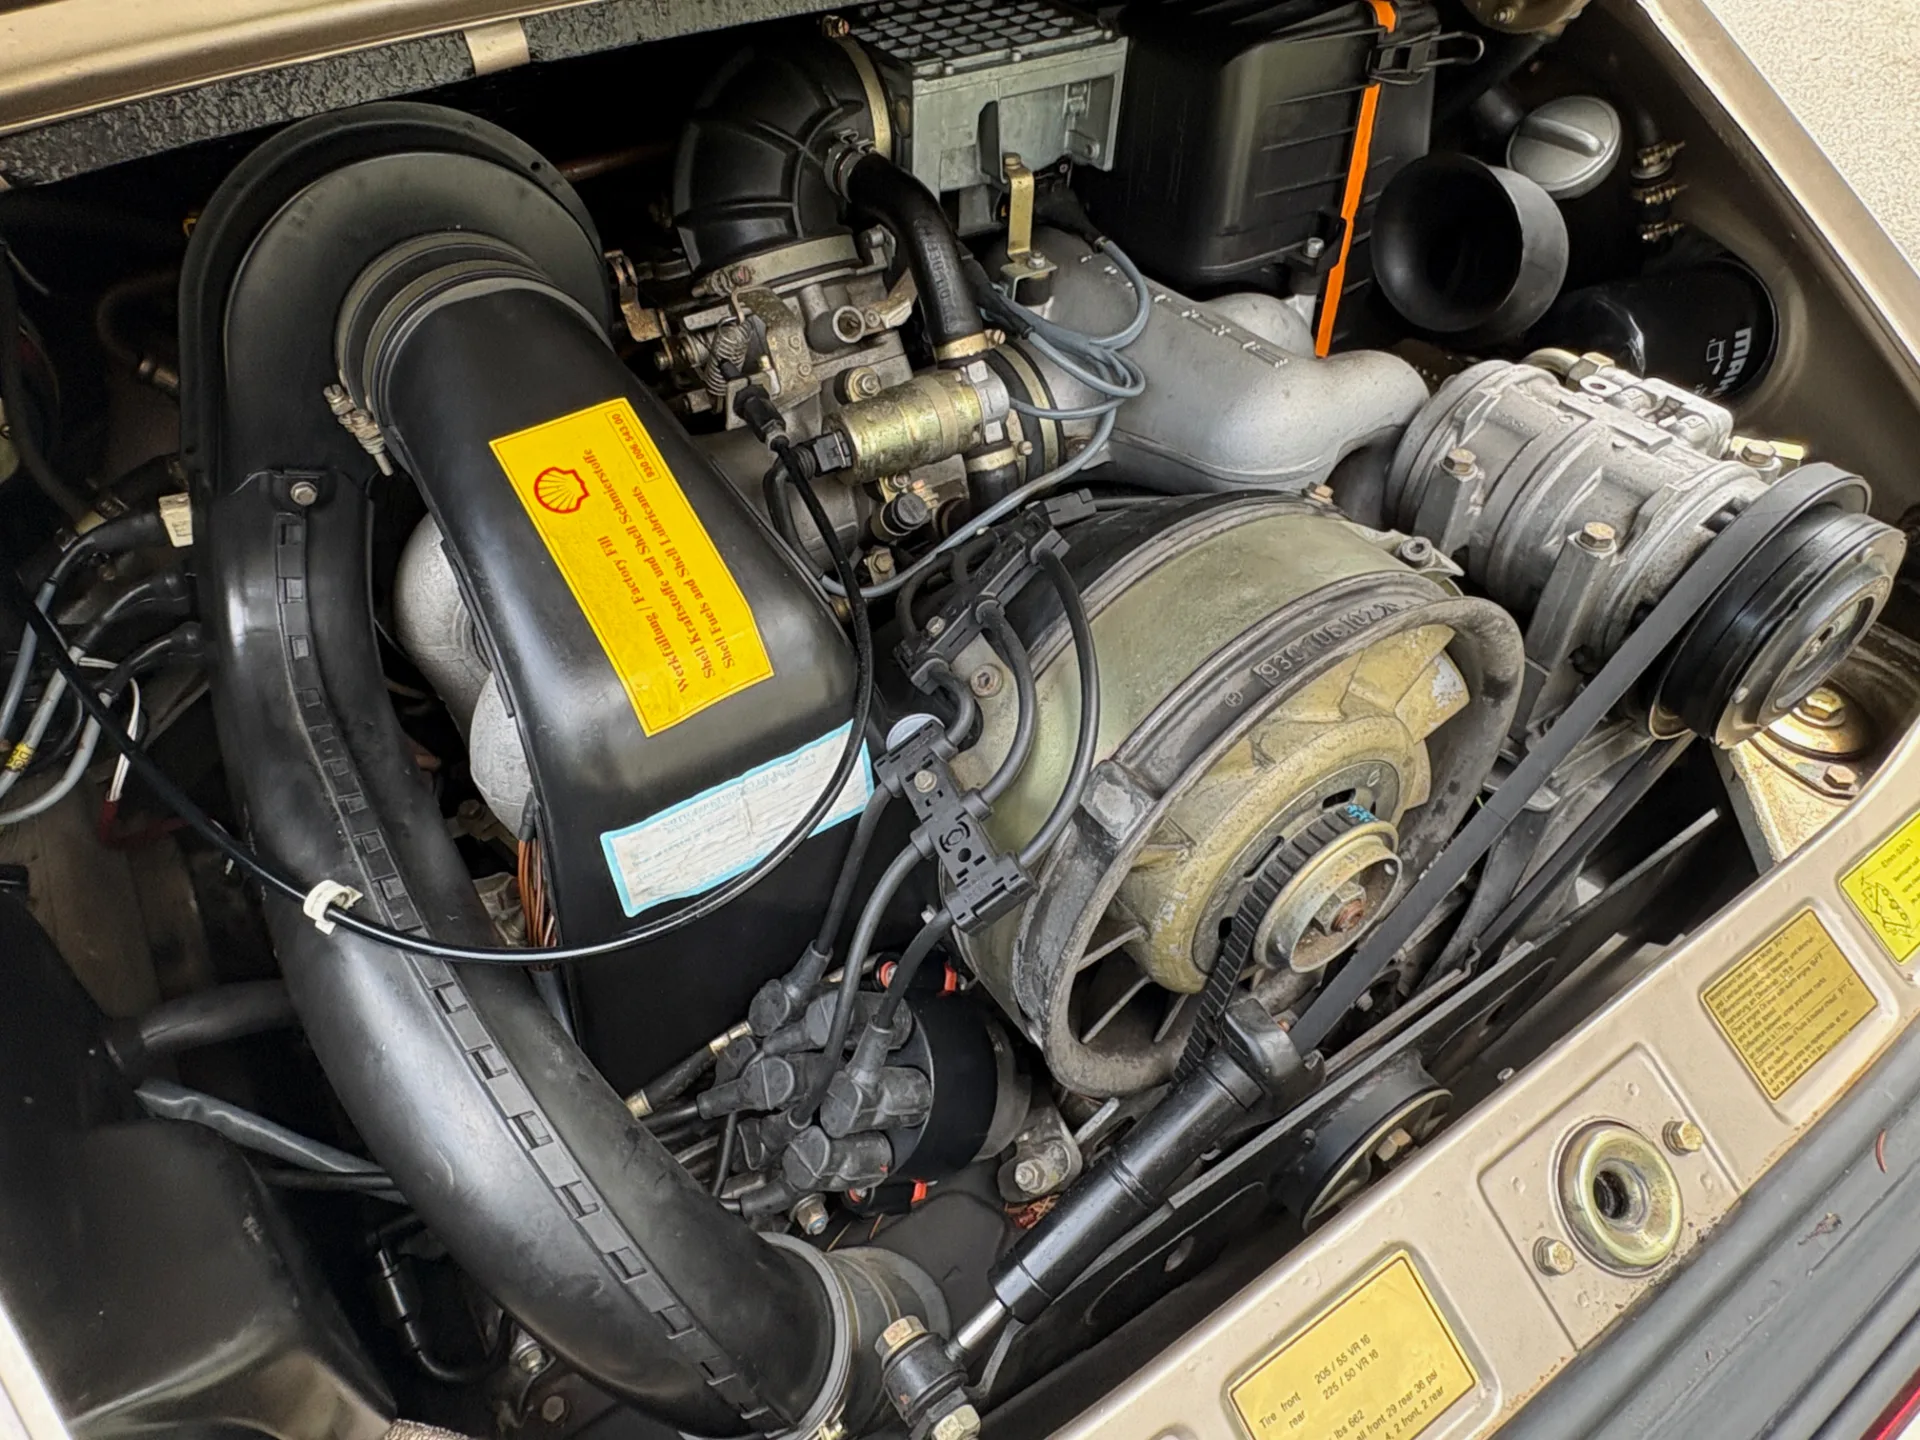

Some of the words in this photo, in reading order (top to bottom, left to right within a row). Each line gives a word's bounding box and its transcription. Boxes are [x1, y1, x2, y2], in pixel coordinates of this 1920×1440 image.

[610, 411, 656, 479] 930.006.543.00
[579, 446, 633, 526] Schmierstoffe
[628, 484, 671, 547] Lubricants
[596, 534, 617, 557] Fill
[624, 524, 651, 556] Shell
[609, 556, 645, 605] Factory
[642, 555, 664, 579] und
[663, 545, 690, 578] Shell
[636, 604, 652, 613] /
[682, 578, 704, 602] and
[655, 578, 701, 646] Kraftstoffe
[696, 600, 723, 635] Fuels
[640, 611, 694, 692] Werkfüllung
[691, 645, 719, 679] Shell
[711, 635, 738, 669] Shell
[1258, 1410, 1277, 1429] Tire
[1279, 1390, 1301, 1412] front
[1313, 1365, 1331, 1384] 205
[1329, 1361, 1337, 1371] /
[1335, 1351, 1348, 1366] 55
[1347, 1341, 1361, 1357] VR
[1359, 1333, 1371, 1347] 16
[1287, 1409, 1307, 1428] rear
[1321, 1381, 1339, 1400] 225
[1337, 1376, 1345, 1386] /
[1343, 1366, 1356, 1381] 50
[1355, 1356, 1369, 1371] VR
[1367, 1348, 1379, 1361] 16
[1365, 1413, 1386, 1434] front
[1384, 1403, 1398, 1418] 29
[1396, 1388, 1415, 1408] rear
[1412, 1379, 1425, 1393] 36
[1424, 1368, 1438, 1384] psi
[1393, 1422, 1401, 1433] 2
[1420, 1399, 1428, 1409] 2
[1427, 1384, 1445, 1403] rear
[1332, 1423, 1348, 1440] lbs
